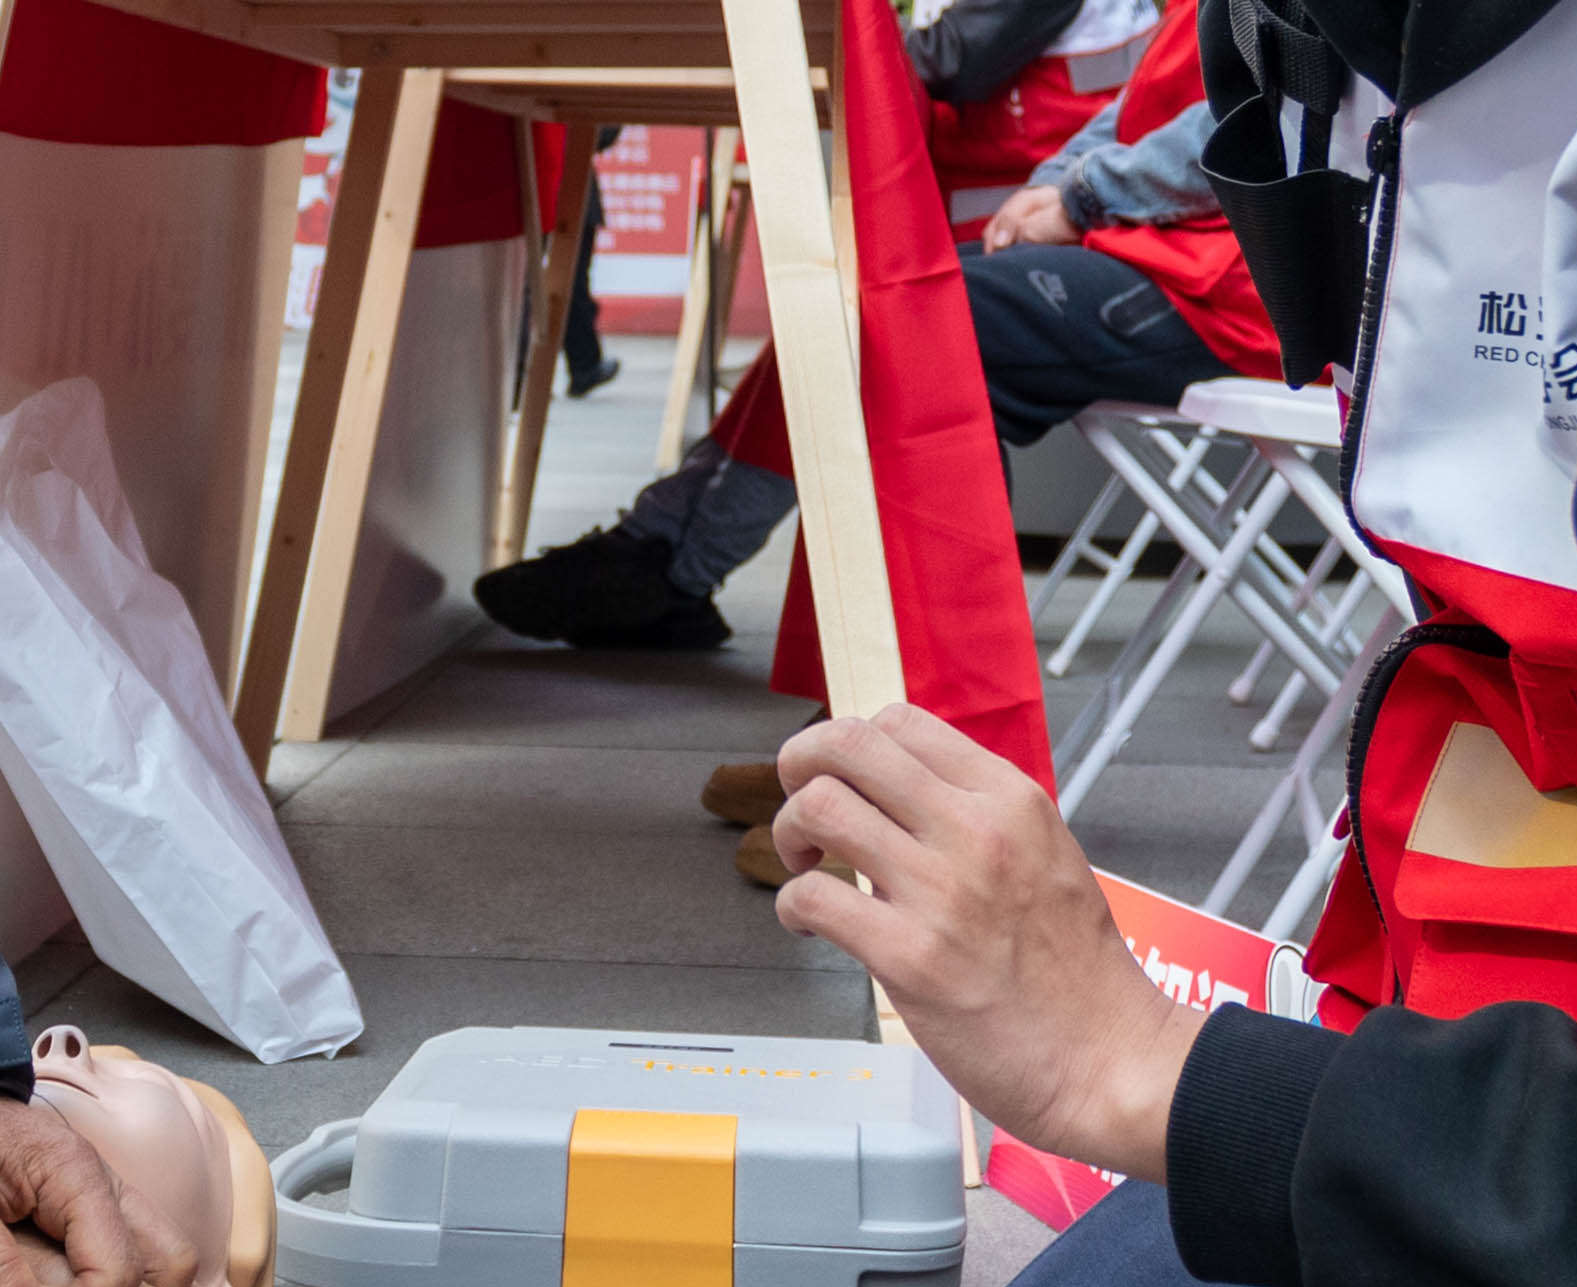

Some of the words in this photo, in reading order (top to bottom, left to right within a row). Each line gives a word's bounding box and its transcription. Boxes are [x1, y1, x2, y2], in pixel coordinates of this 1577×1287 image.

[1474, 345, 1519, 363] RED
[631, 1058, 833, 1080] Trainer
[849, 1067, 873, 1081] 3
